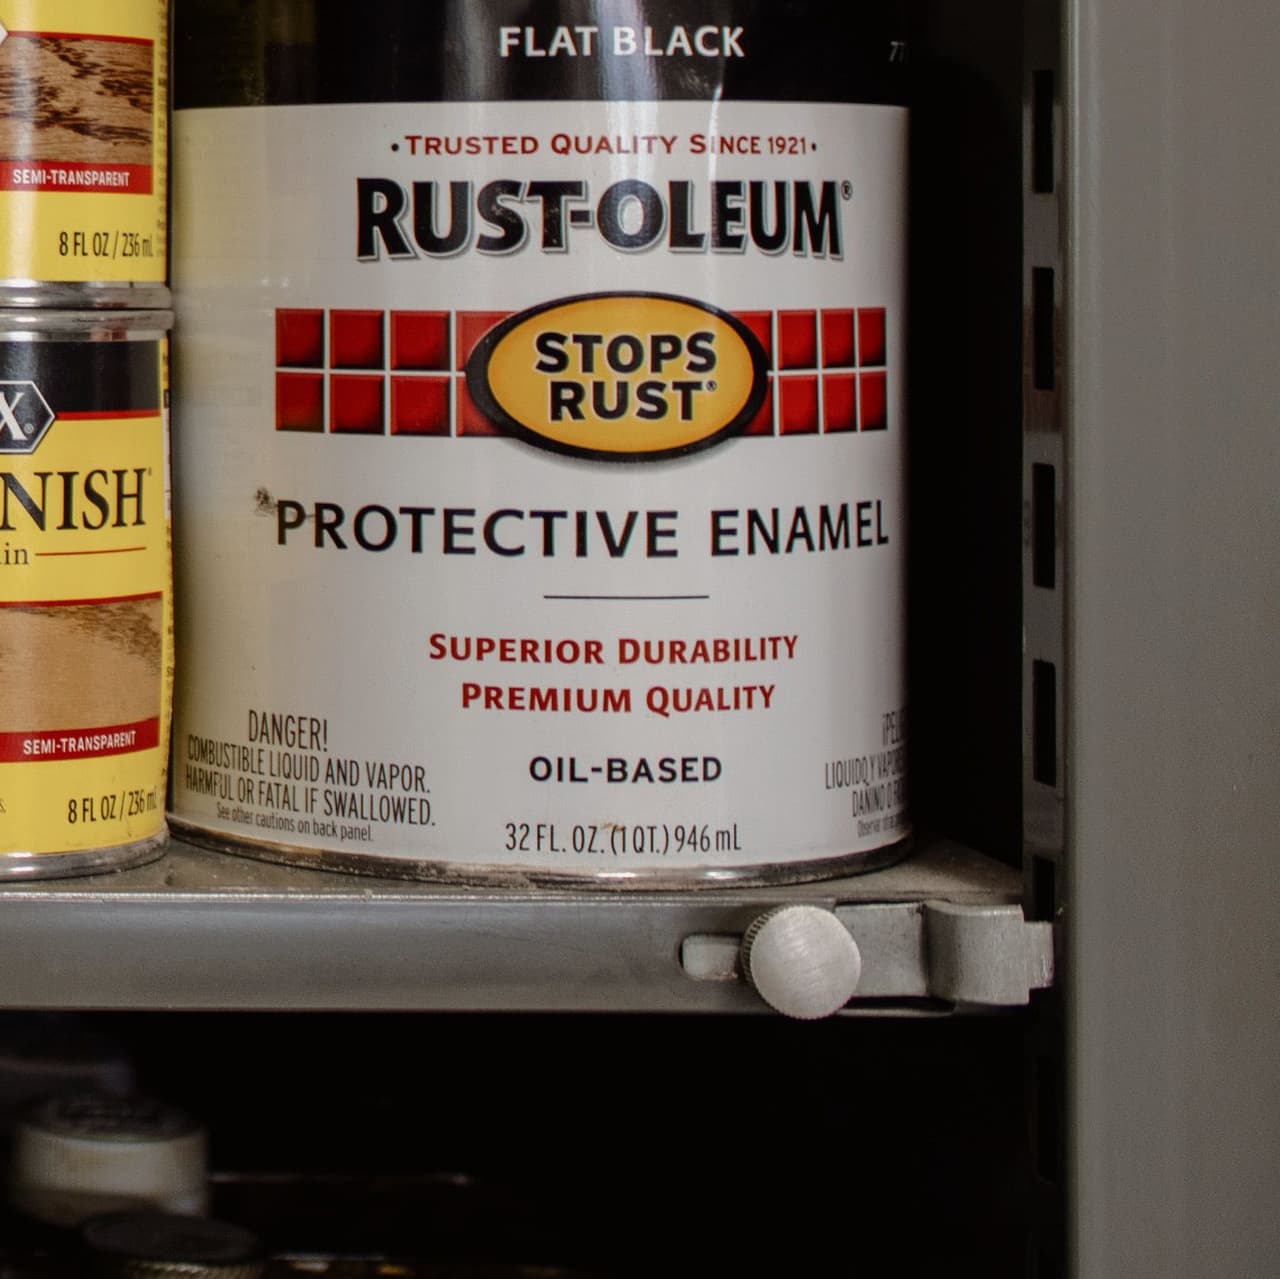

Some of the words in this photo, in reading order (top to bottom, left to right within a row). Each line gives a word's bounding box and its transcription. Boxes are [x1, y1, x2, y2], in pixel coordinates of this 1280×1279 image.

[500, 27, 598, 58] FLAT
[614, 25, 745, 57] BLACK
[405, 135, 538, 155] TRUSTED
[550, 133, 676, 157] QUALITY
[690, 133, 762, 155] SINCE
[767, 137, 807, 155] 1921
[356, 177, 844, 260] RUST-OLEUM
[535, 332, 716, 373] STOPS
[550, 381, 705, 421] RUST
[276, 500, 680, 558] PROTECTIVE
[710, 500, 889, 557] ENAMEL
[430, 634, 604, 664] SUPERIOR
[617, 634, 798, 664] DURABILITY
[462, 683, 631, 712] PREMIUM
[646, 684, 776, 718] QUALITY
[23, 730, 136, 755] SEMI-TRANSPARENT
[248, 709, 328, 752] DANGER!
[189, 735, 265, 775] COMBUSTIBLE
[270, 750, 320, 782] LIQUID
[325, 757, 359, 786] AND
[365, 761, 430, 793] VAPOR.
[529, 756, 721, 783] OIL-BASED
[186, 766, 233, 801] HARMFUL
[239, 778, 254, 804] OR
[259, 781, 299, 812] FATAL
[305, 788, 319, 813] IF
[324, 790, 436, 826] SWALLOWED.
[217, 803, 230, 819] See
[232, 809, 254, 824] other
[256, 815, 295, 832] cautions
[298, 820, 310, 834] on
[313, 820, 337, 837] back
[505, 823, 530, 851] 32
[537, 824, 566, 852] FL.
[573, 826, 604, 854] OZ.
[633, 825, 669, 855] QT.)
[675, 825, 710, 852] 946
[716, 824, 741, 851] mL
